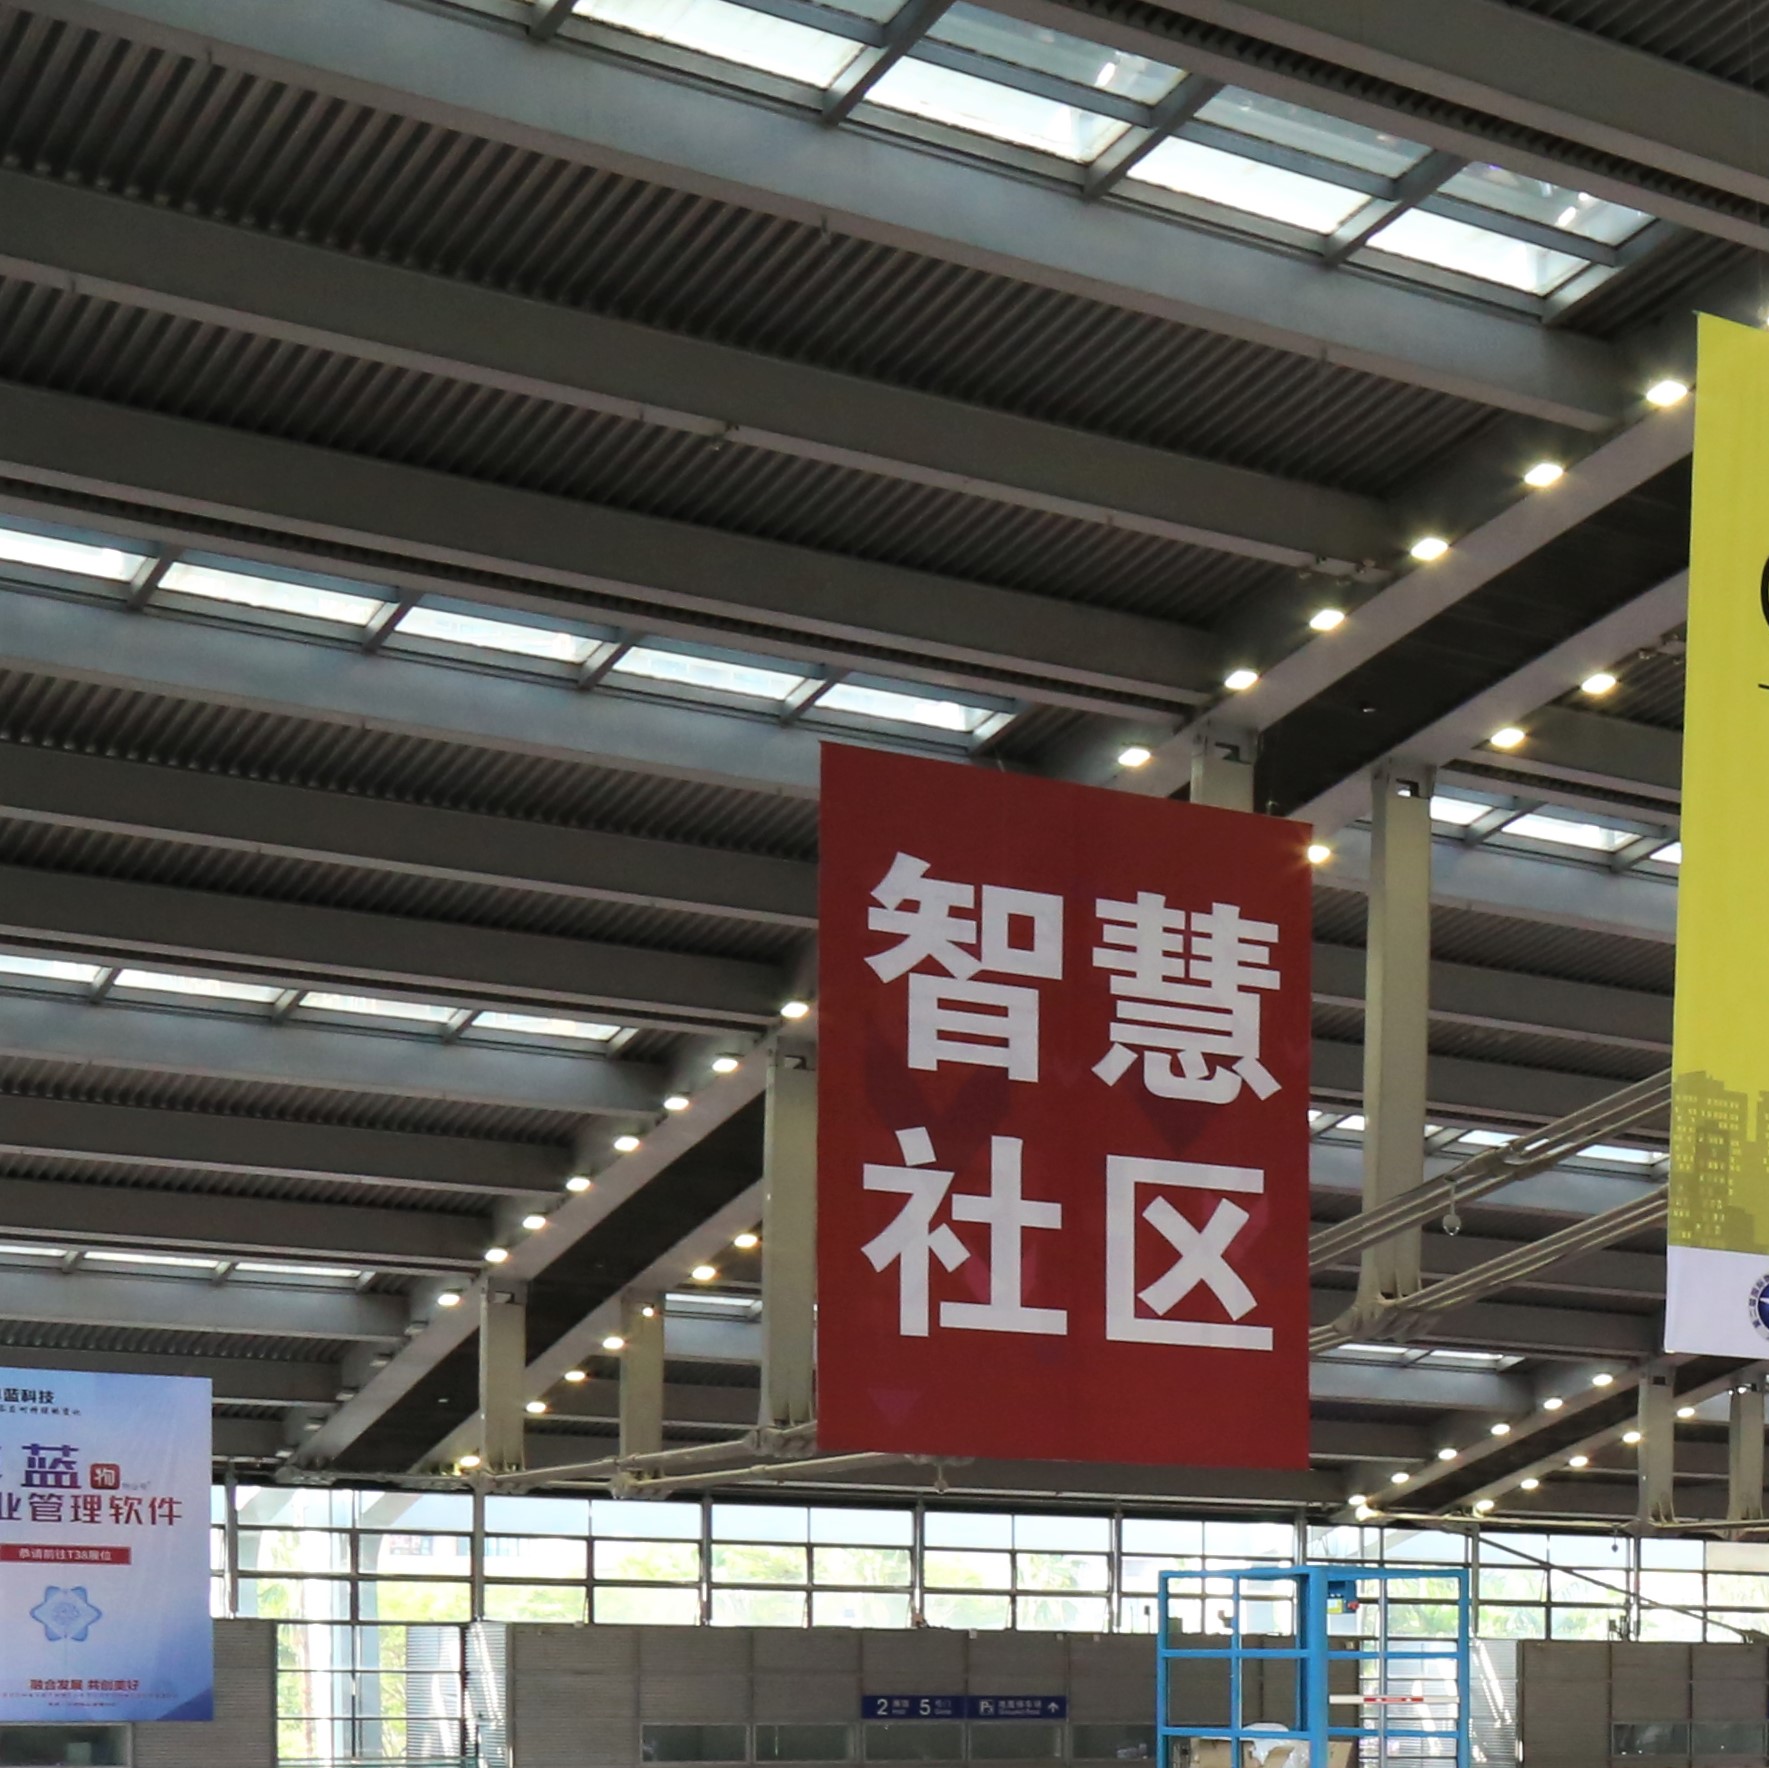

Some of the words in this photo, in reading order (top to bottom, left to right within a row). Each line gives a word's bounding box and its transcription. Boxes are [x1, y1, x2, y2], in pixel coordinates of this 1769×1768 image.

[862, 851, 1282, 1105] 智慧
[861, 1126, 1274, 1351] 社区
[877, 1699, 888, 1716] 2
[919, 1699, 931, 1715] 5
